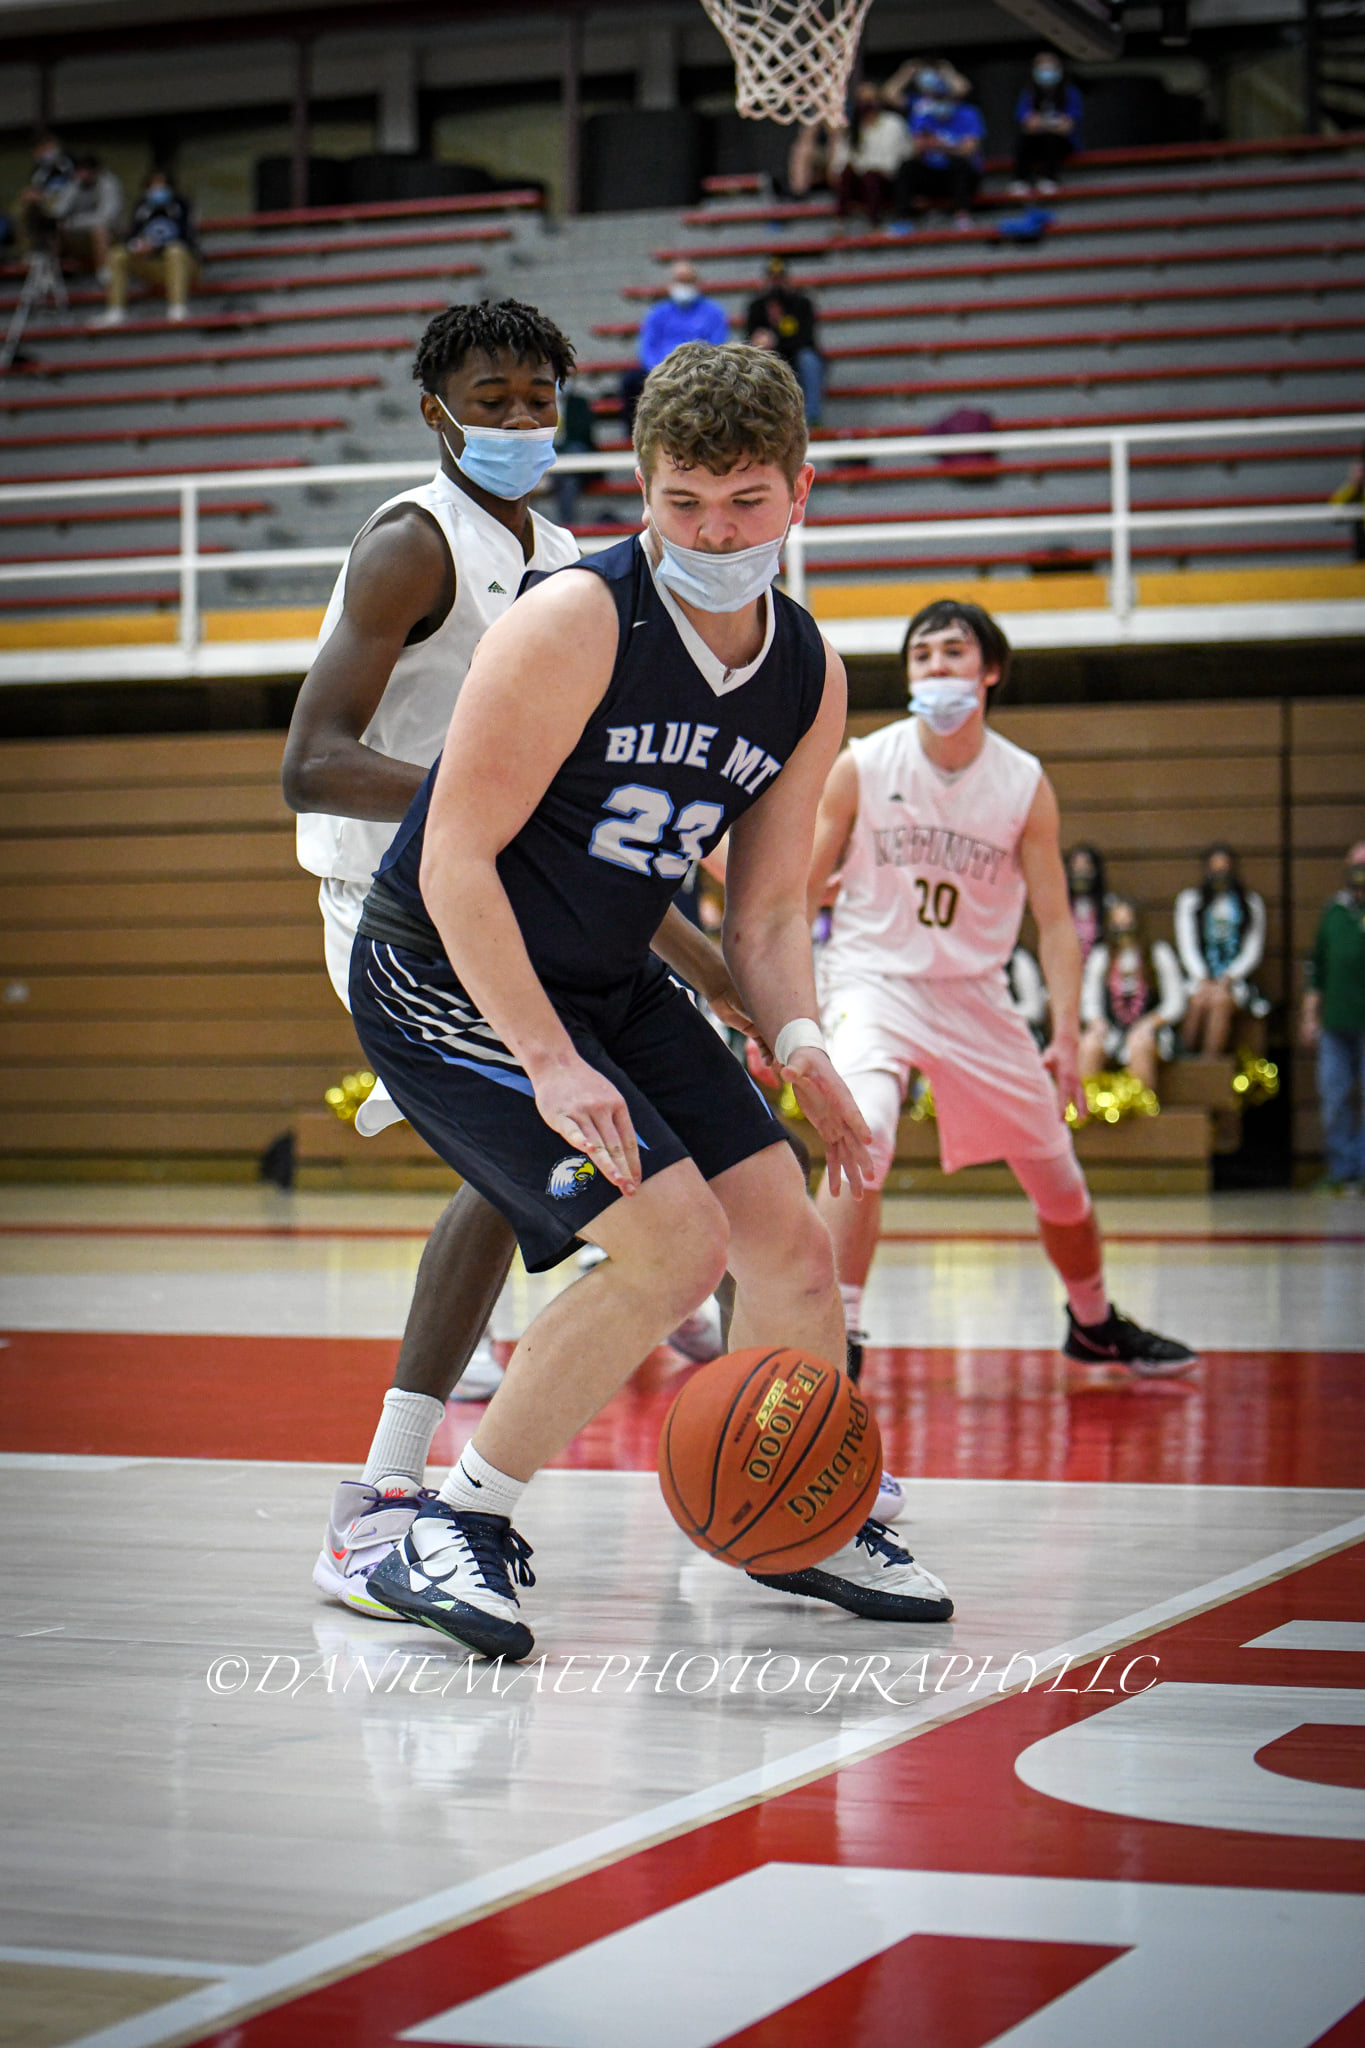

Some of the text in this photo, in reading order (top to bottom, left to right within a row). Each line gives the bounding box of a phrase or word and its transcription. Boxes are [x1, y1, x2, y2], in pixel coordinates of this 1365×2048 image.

[605, 722, 782, 795] BLUE MT
[588, 783, 724, 879] 23
[915, 878, 959, 928] 20
[748, 1362, 824, 1482] TF-1000
[788, 1390, 869, 1523] SPALDING
